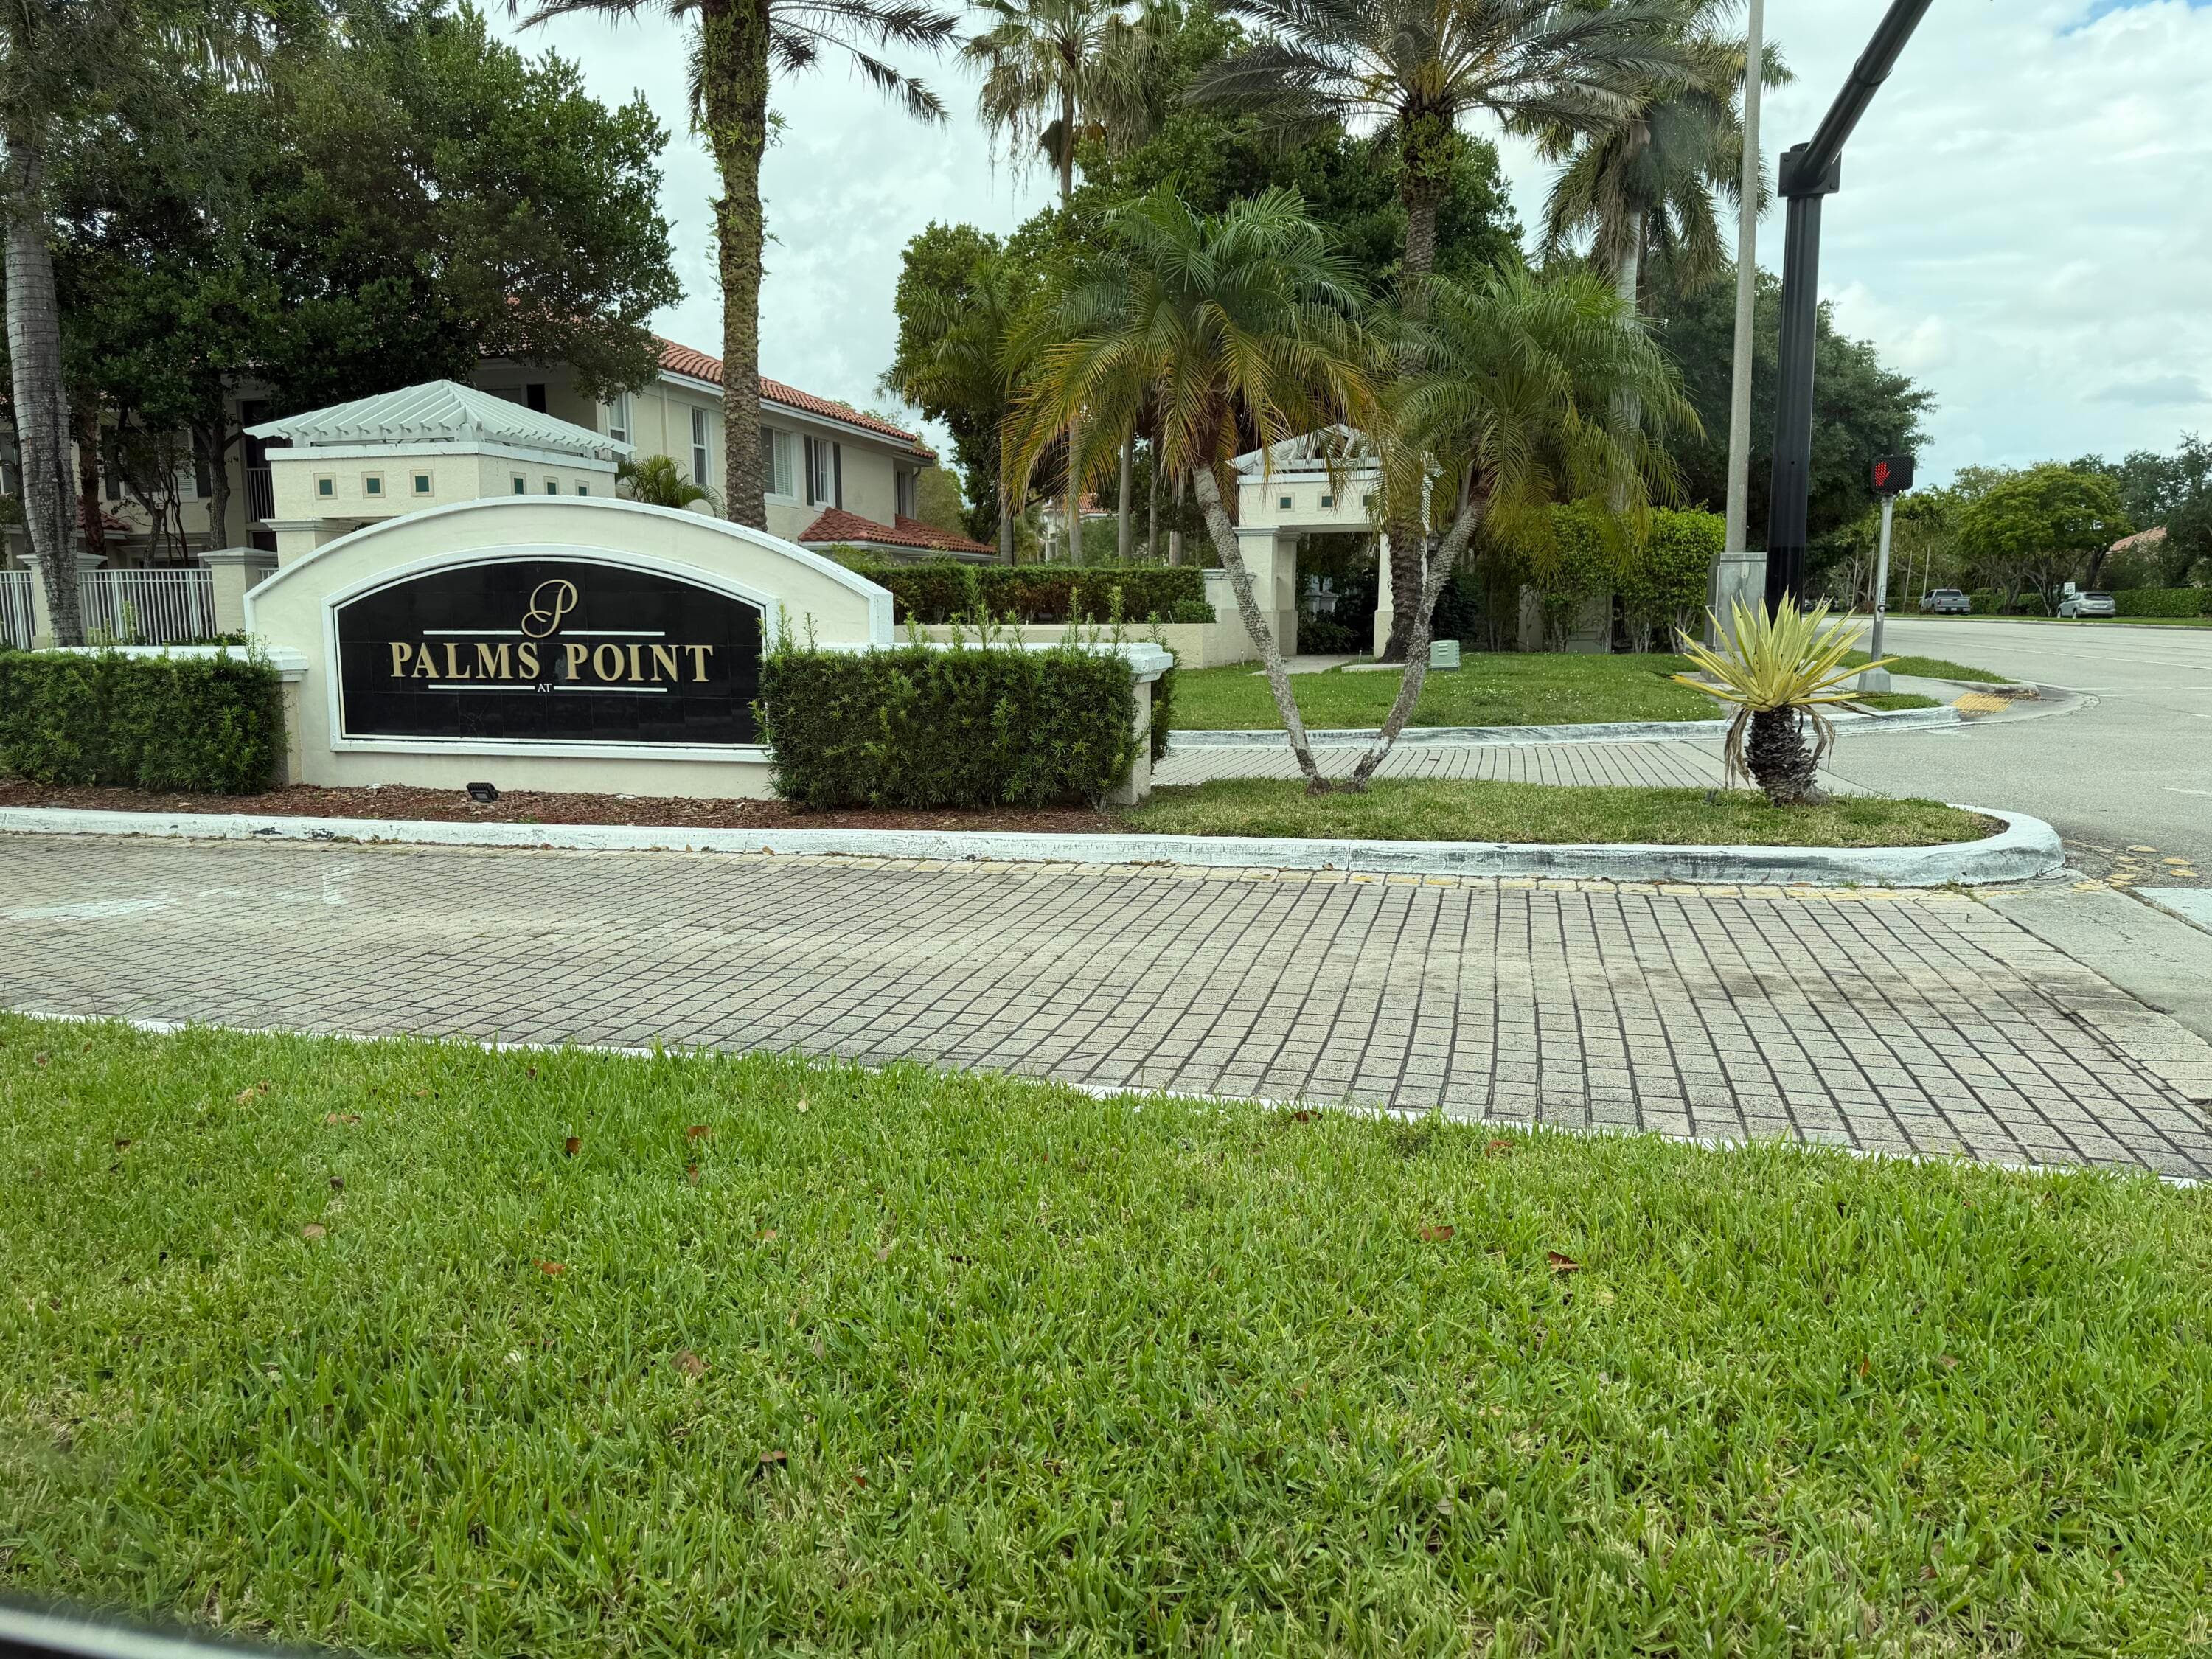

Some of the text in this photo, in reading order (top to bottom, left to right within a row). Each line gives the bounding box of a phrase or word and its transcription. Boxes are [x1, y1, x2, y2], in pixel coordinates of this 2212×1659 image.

[389, 641, 714, 683] PALMS POINT
[537, 683, 552, 692] AT
